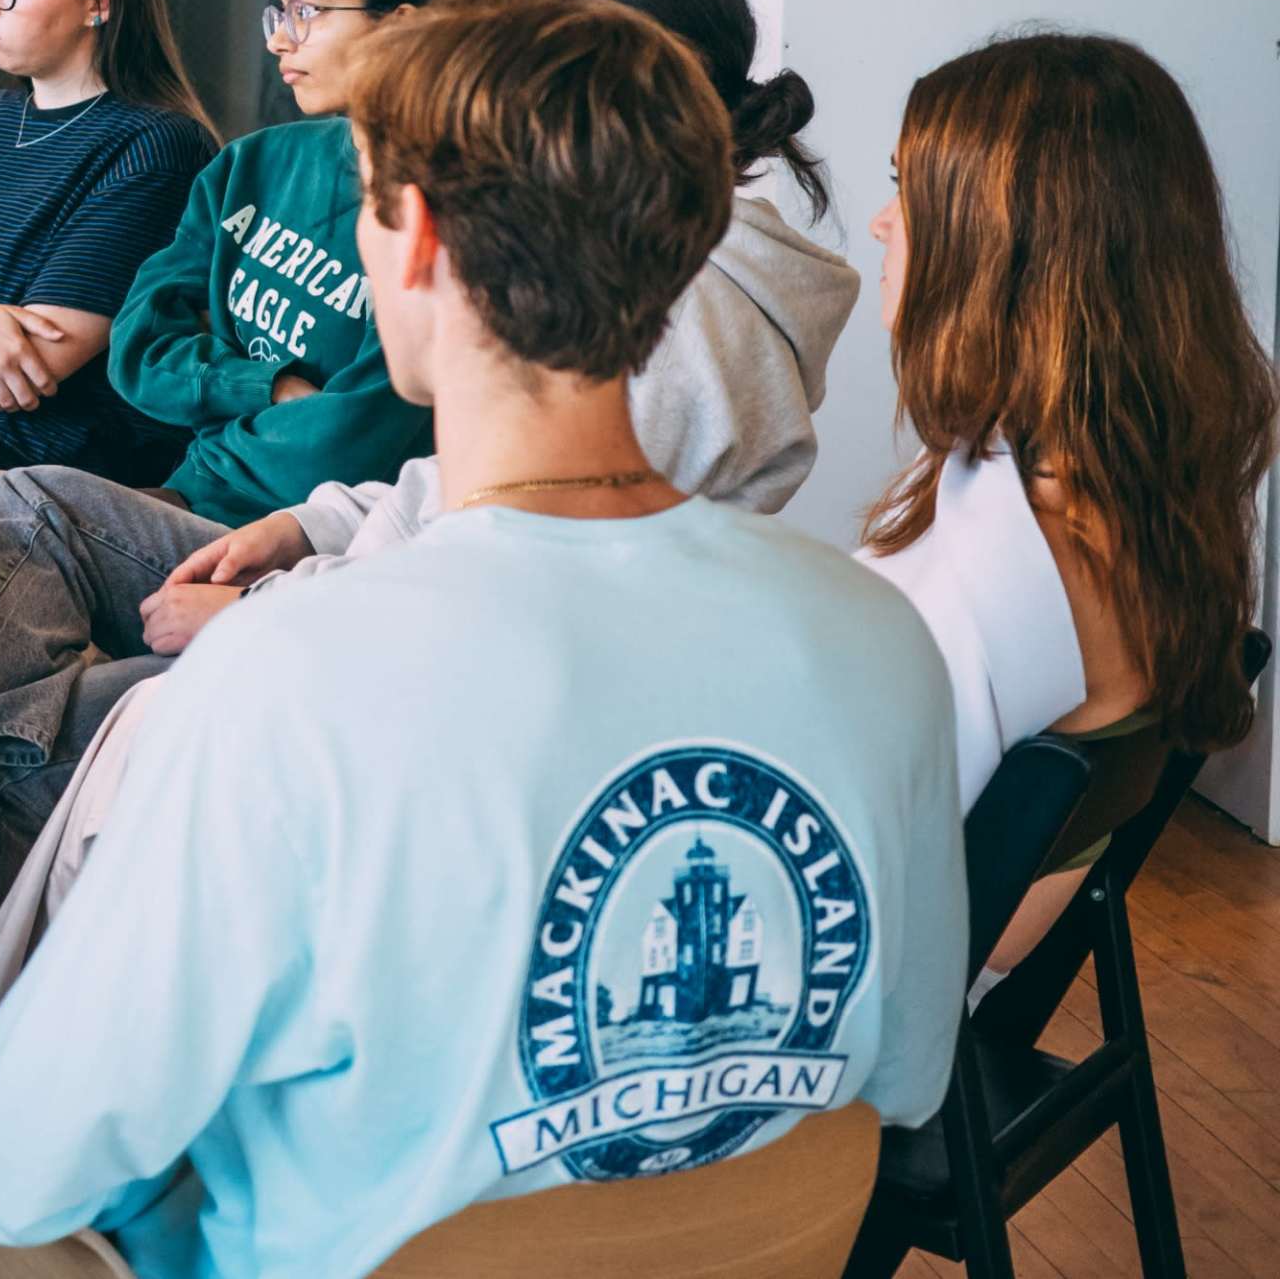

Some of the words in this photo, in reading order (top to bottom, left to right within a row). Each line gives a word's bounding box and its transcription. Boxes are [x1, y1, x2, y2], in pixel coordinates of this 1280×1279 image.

[228, 268, 316, 358] EAGLE
[530, 762, 732, 1067] MACKINAC
[761, 787, 857, 1028] ISLAND
[534, 1063, 828, 1153] MICHIGAN
